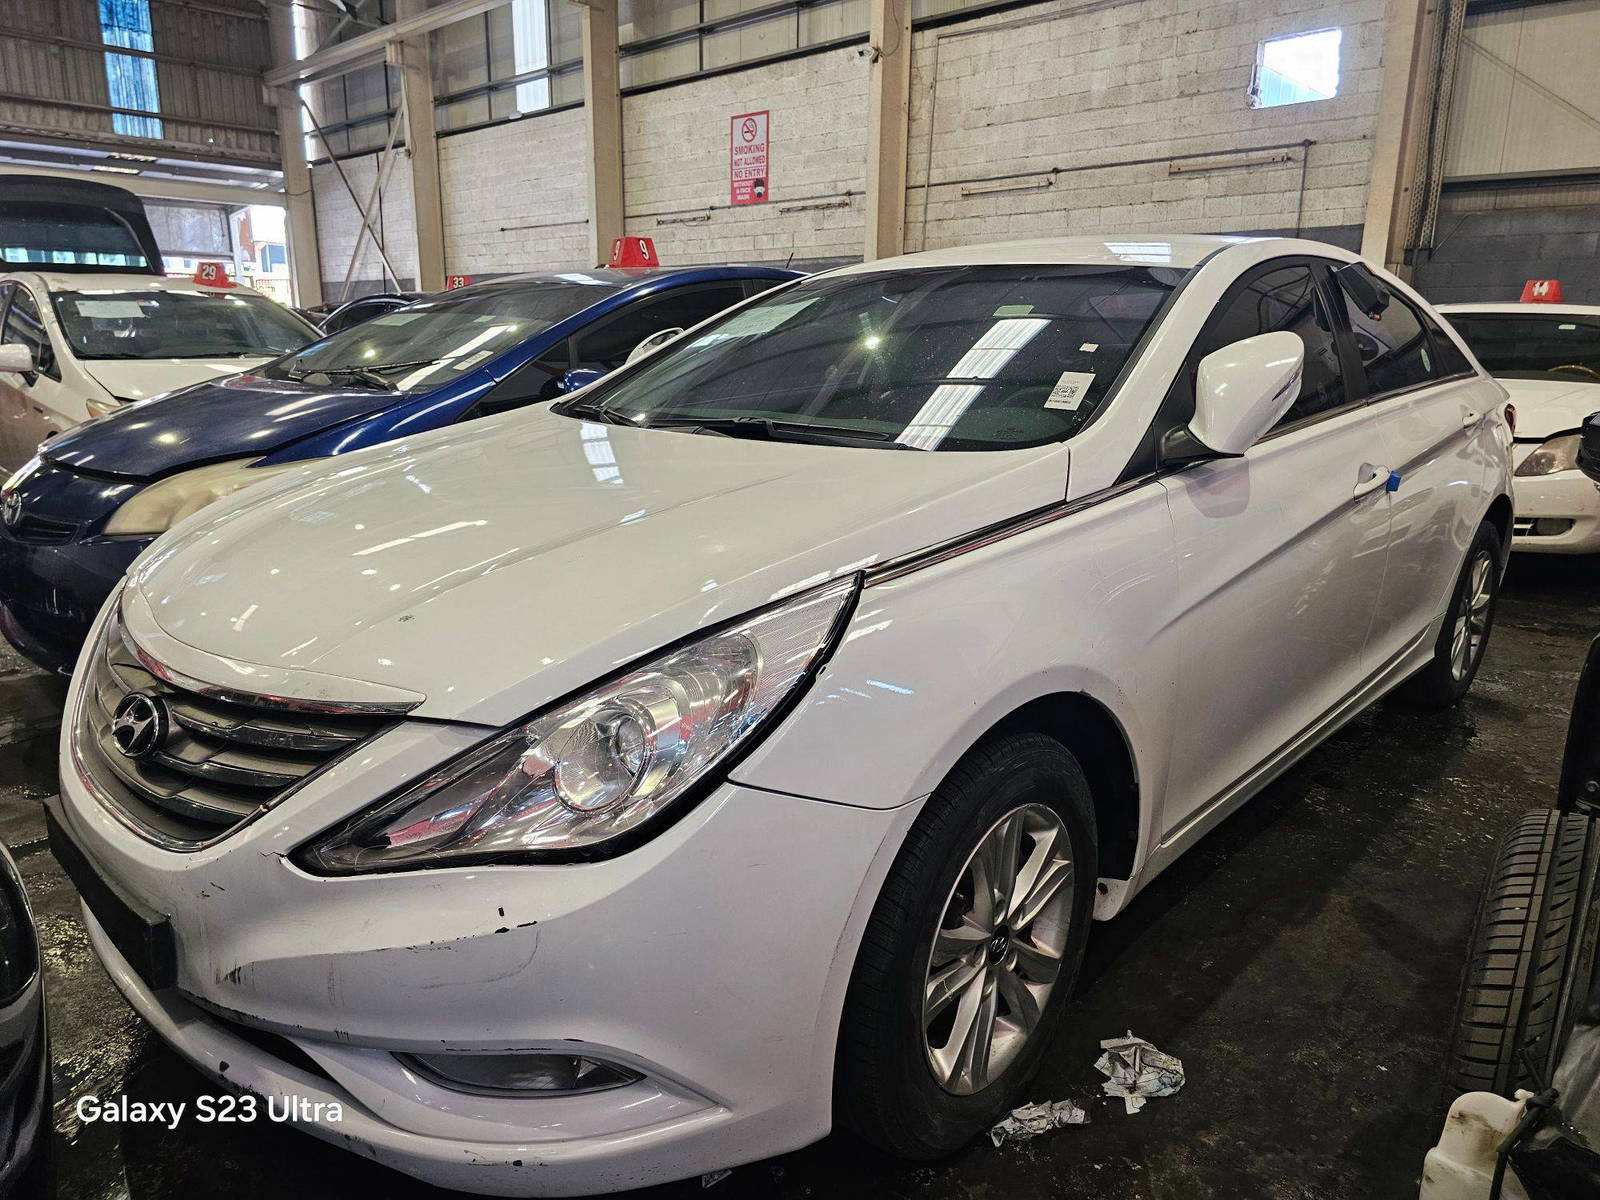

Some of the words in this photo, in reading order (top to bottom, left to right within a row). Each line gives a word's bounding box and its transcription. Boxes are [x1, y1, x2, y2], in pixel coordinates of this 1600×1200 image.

[734, 143, 765, 155] SMOKING
[734, 158, 743, 167] NOT
[744, 155, 765, 165] ALLOWED
[734, 170, 743, 179] NO
[744, 167, 765, 178] ENTRY
[639, 239, 650, 260] 9
[202, 264, 217, 280] 29
[453, 276, 465, 289] 33
